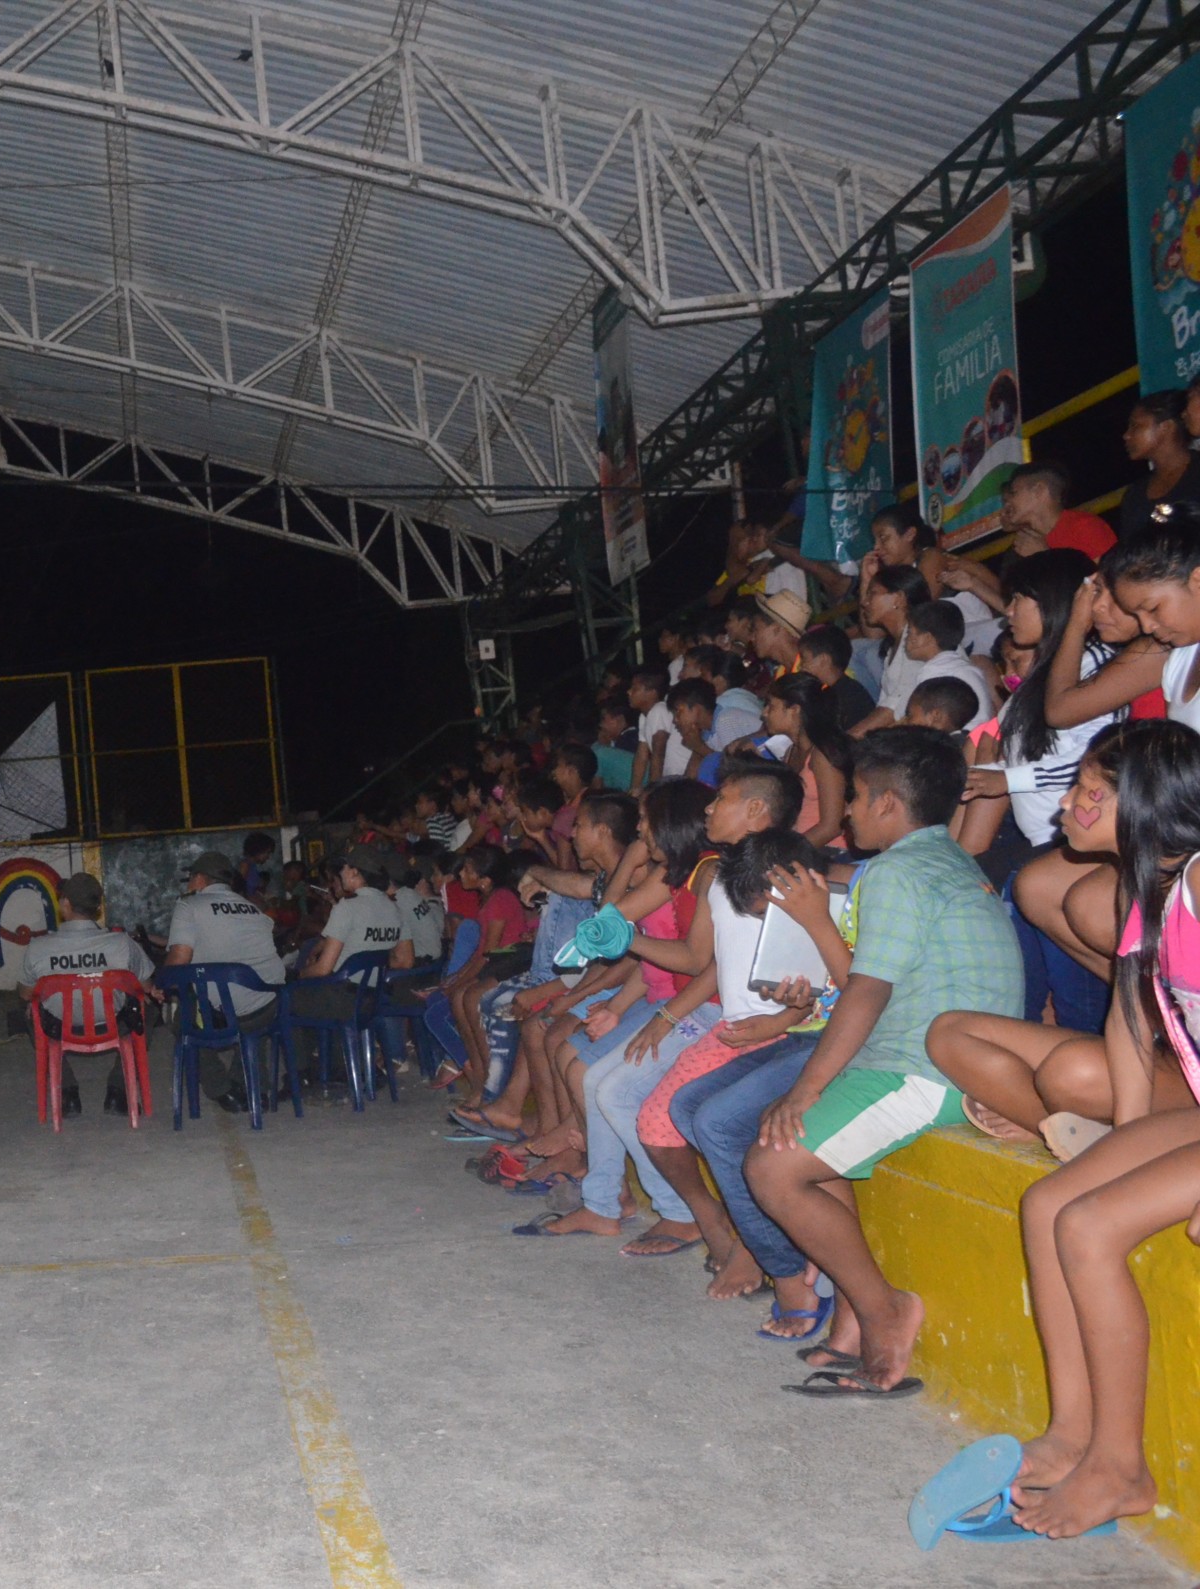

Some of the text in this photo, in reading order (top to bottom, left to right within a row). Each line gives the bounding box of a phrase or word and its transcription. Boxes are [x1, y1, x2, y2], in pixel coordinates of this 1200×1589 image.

[934, 334, 1003, 405] FAMILIA
[211, 902, 260, 915] POLICIA
[364, 927, 401, 942] POLICIA
[50, 952, 108, 970] POLICIA
